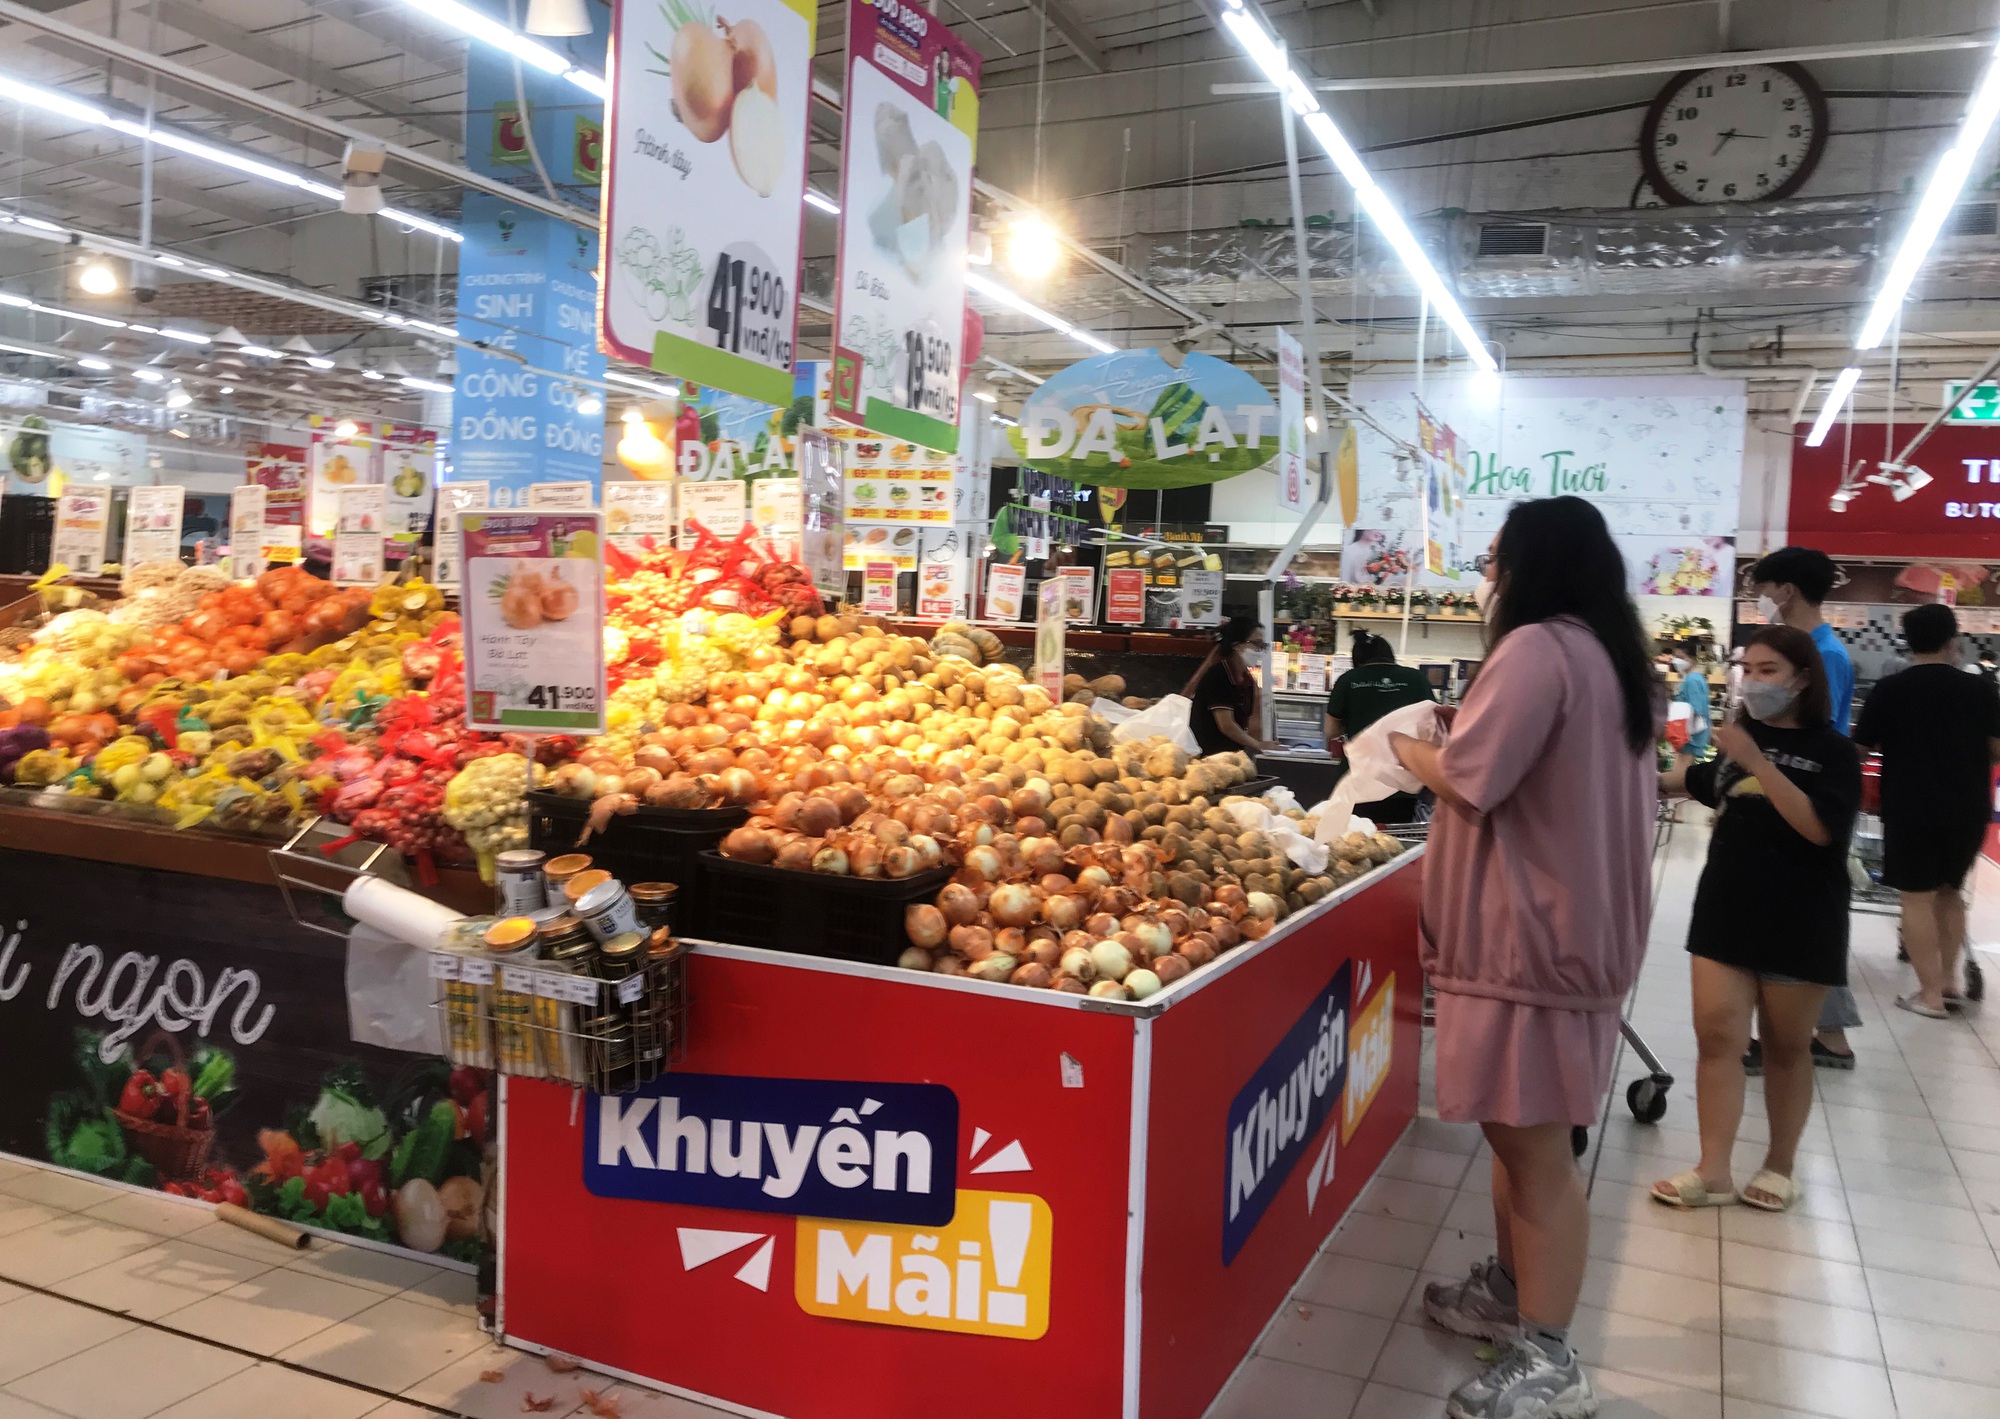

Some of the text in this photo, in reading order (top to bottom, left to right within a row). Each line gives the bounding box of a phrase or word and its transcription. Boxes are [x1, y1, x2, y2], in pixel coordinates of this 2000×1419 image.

[1725, 73, 1747, 87] 12
[1762, 80, 1771, 93] 1
[1696, 85, 1713, 98] 11
[1782, 98, 1796, 111] 2
[1677, 107, 1698, 121] 10
[1788, 124, 1801, 138] 3
[1665, 133, 1678, 146] 9
[1674, 160, 1688, 174] 8
[1775, 154, 1788, 168] 4
[1696, 178, 1709, 192] 7
[1757, 173, 1769, 187] 5
[1723, 183, 1737, 196] 6
[475, 293, 533, 318] SINH
[462, 368, 538, 402] CỘNG
[1022, 391, 1275, 463] ĐÀ LẠT
[1468, 449, 1533, 495] Hoa
[46, 942, 277, 1064] ngon
[1229, 994, 1346, 1224] Khuyến
[598, 1097, 933, 1199] Khuyến
[816, 1200, 1033, 1327] Mãi!
